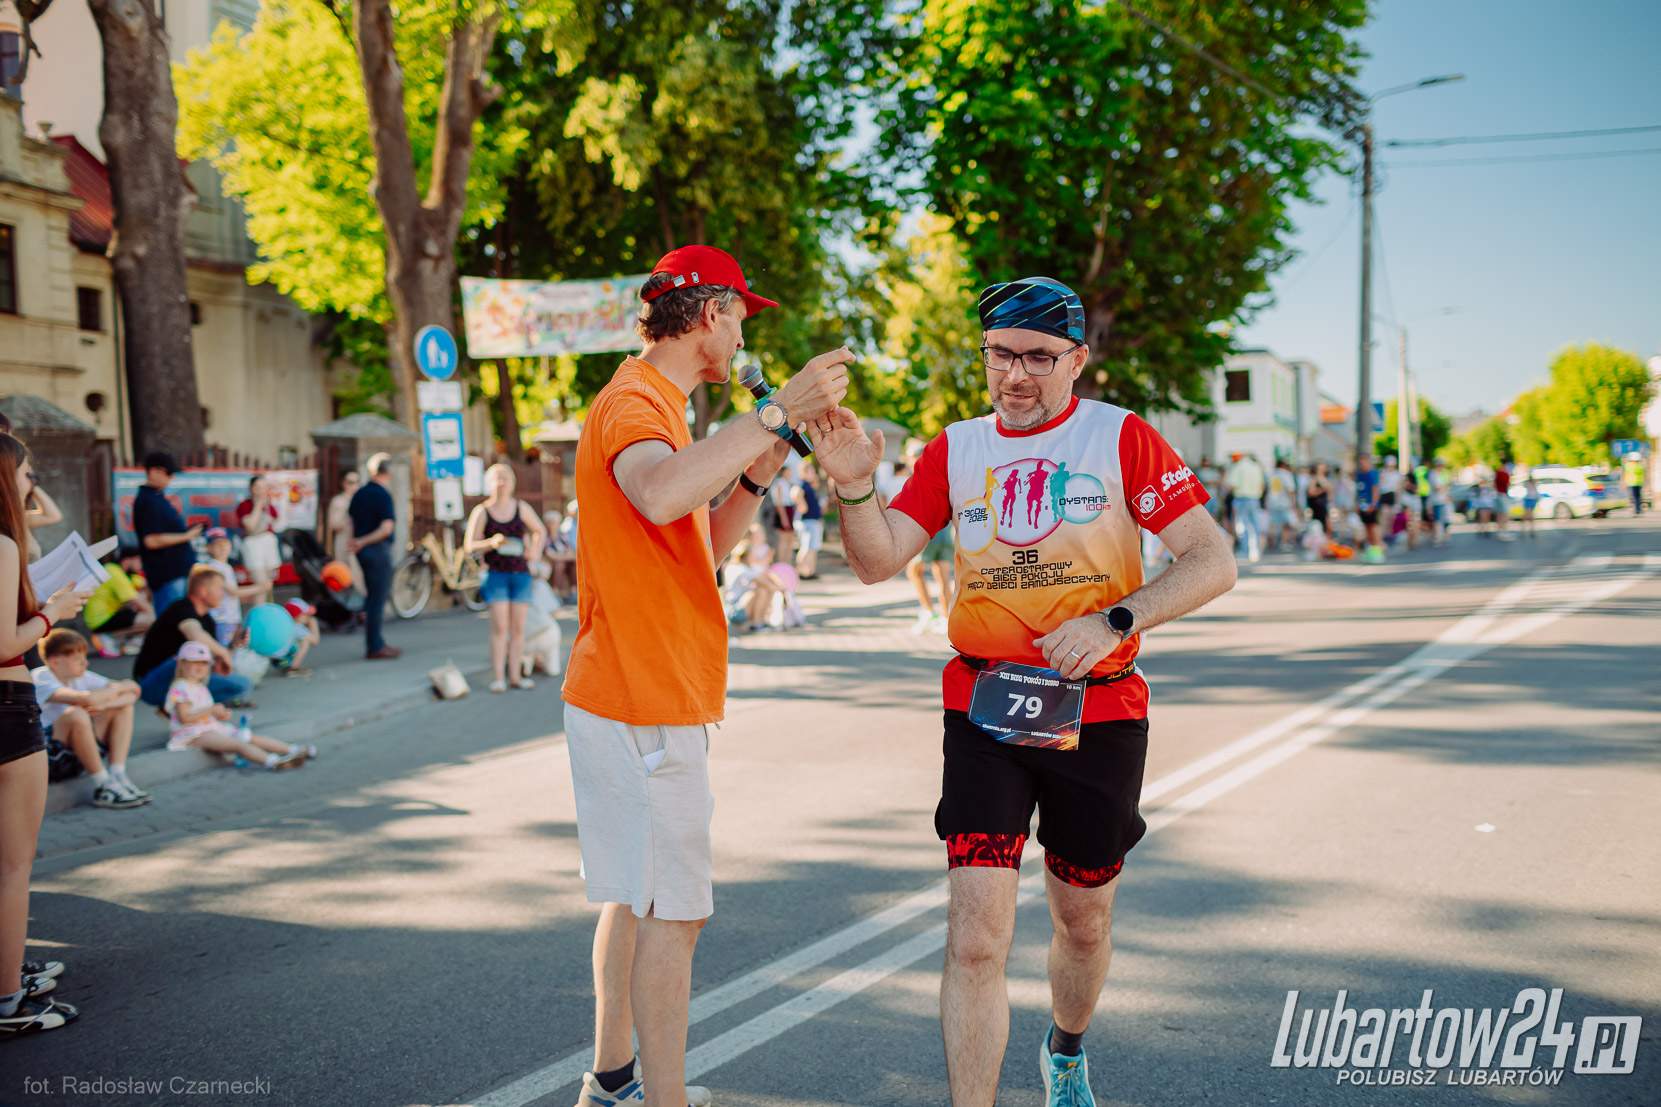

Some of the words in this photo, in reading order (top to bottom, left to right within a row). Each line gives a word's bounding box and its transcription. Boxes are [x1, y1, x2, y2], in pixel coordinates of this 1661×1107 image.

[1012, 549, 1039, 566] 36
[993, 573, 1017, 582] BIEG
[1021, 570, 1063, 581] POKOJU
[987, 581, 1018, 590] DZIECI
[1006, 693, 1043, 719] 79
